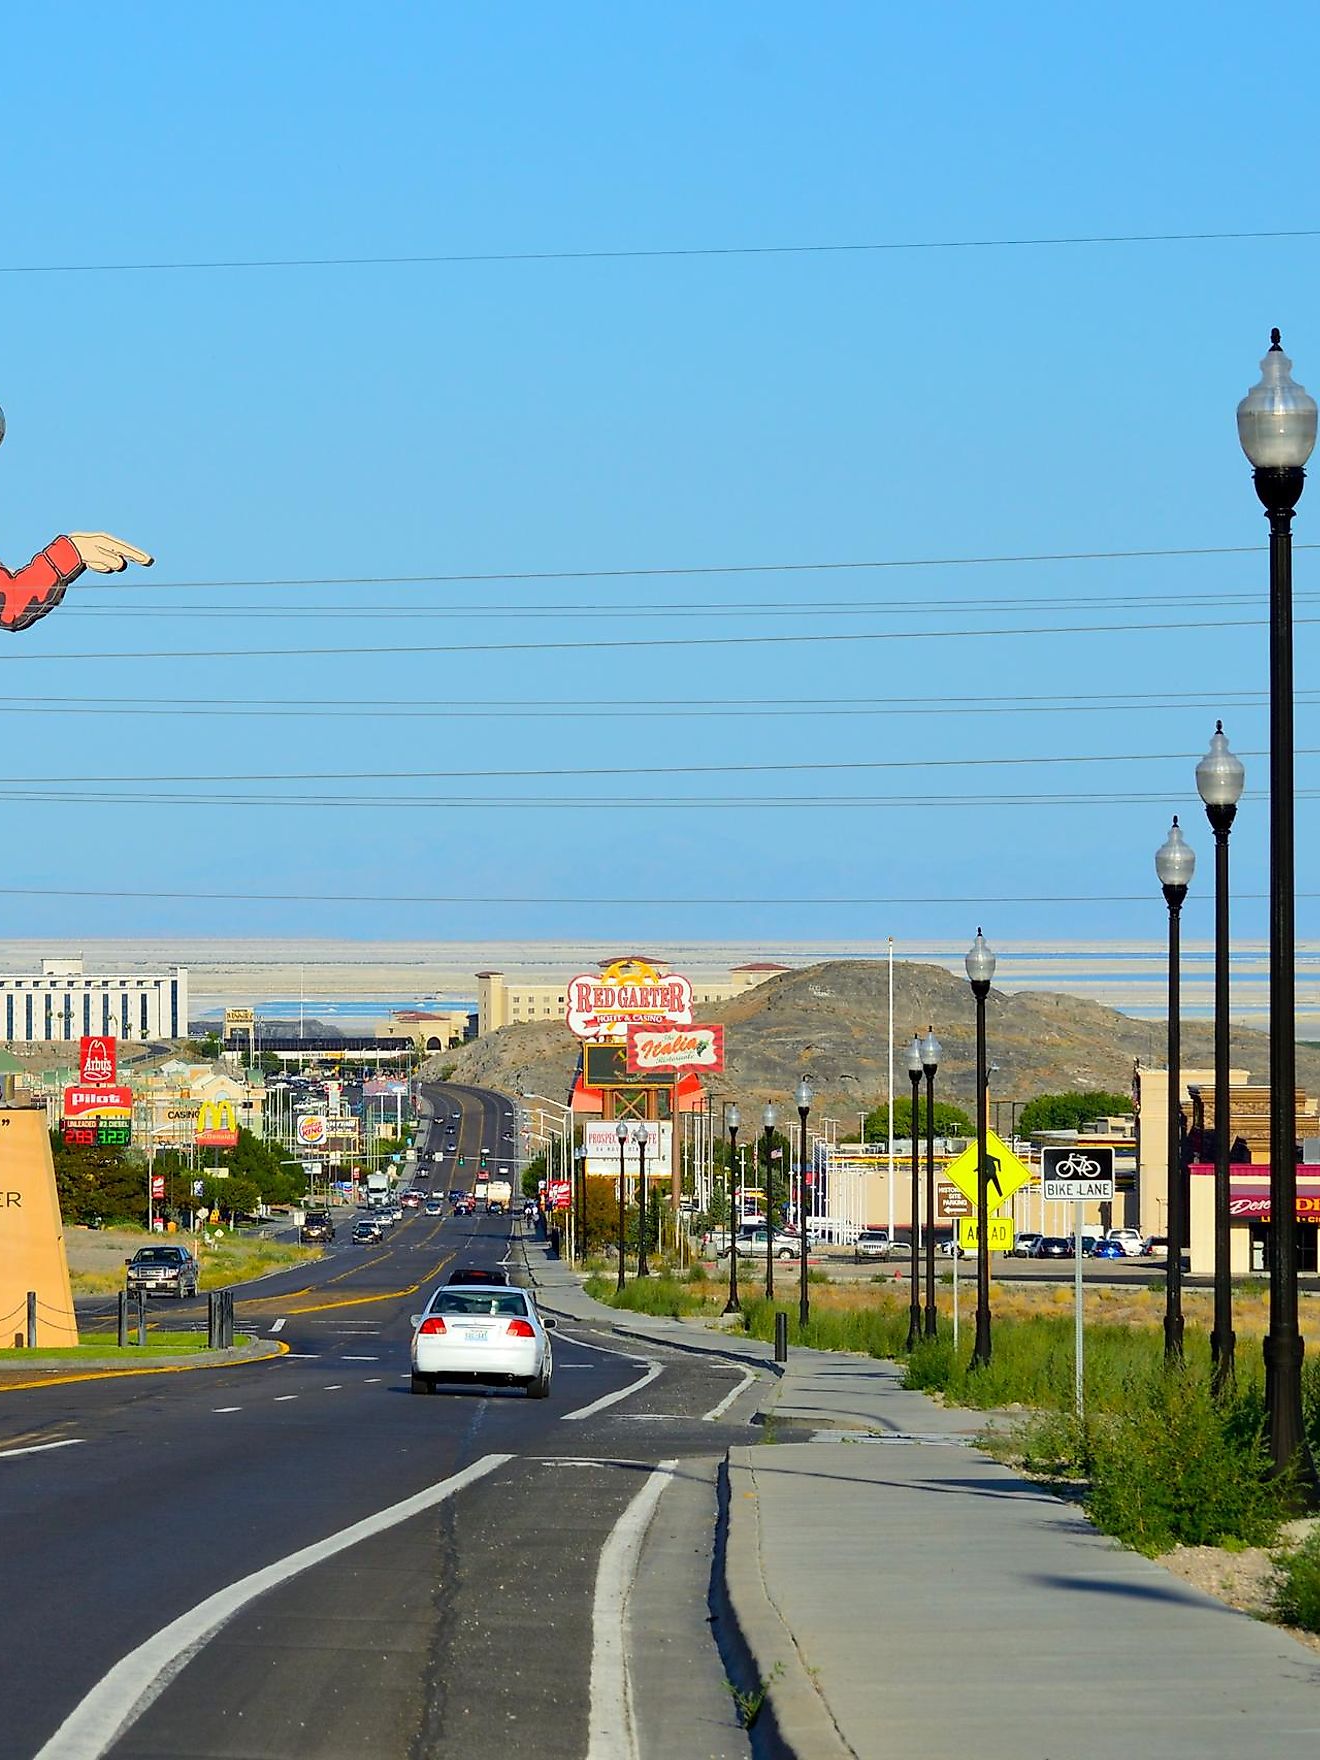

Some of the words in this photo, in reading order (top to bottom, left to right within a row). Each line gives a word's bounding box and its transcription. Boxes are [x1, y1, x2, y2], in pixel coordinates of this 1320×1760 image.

[575, 983, 615, 1013] RED
[617, 983, 685, 1013] GARTER
[597, 1014, 622, 1023] HOTEL
[623, 1014, 631, 1022] &
[632, 1014, 663, 1024] CASINO
[641, 1034, 697, 1060] Italia
[84, 1057, 112, 1074] Arby's
[72, 1093, 120, 1106] Pilot
[301, 1125, 323, 1137] KING
[1047, 1184, 1073, 1196] BIKE
[1079, 1184, 1110, 1196] LANE
[967, 1226, 1006, 1241] AAD
